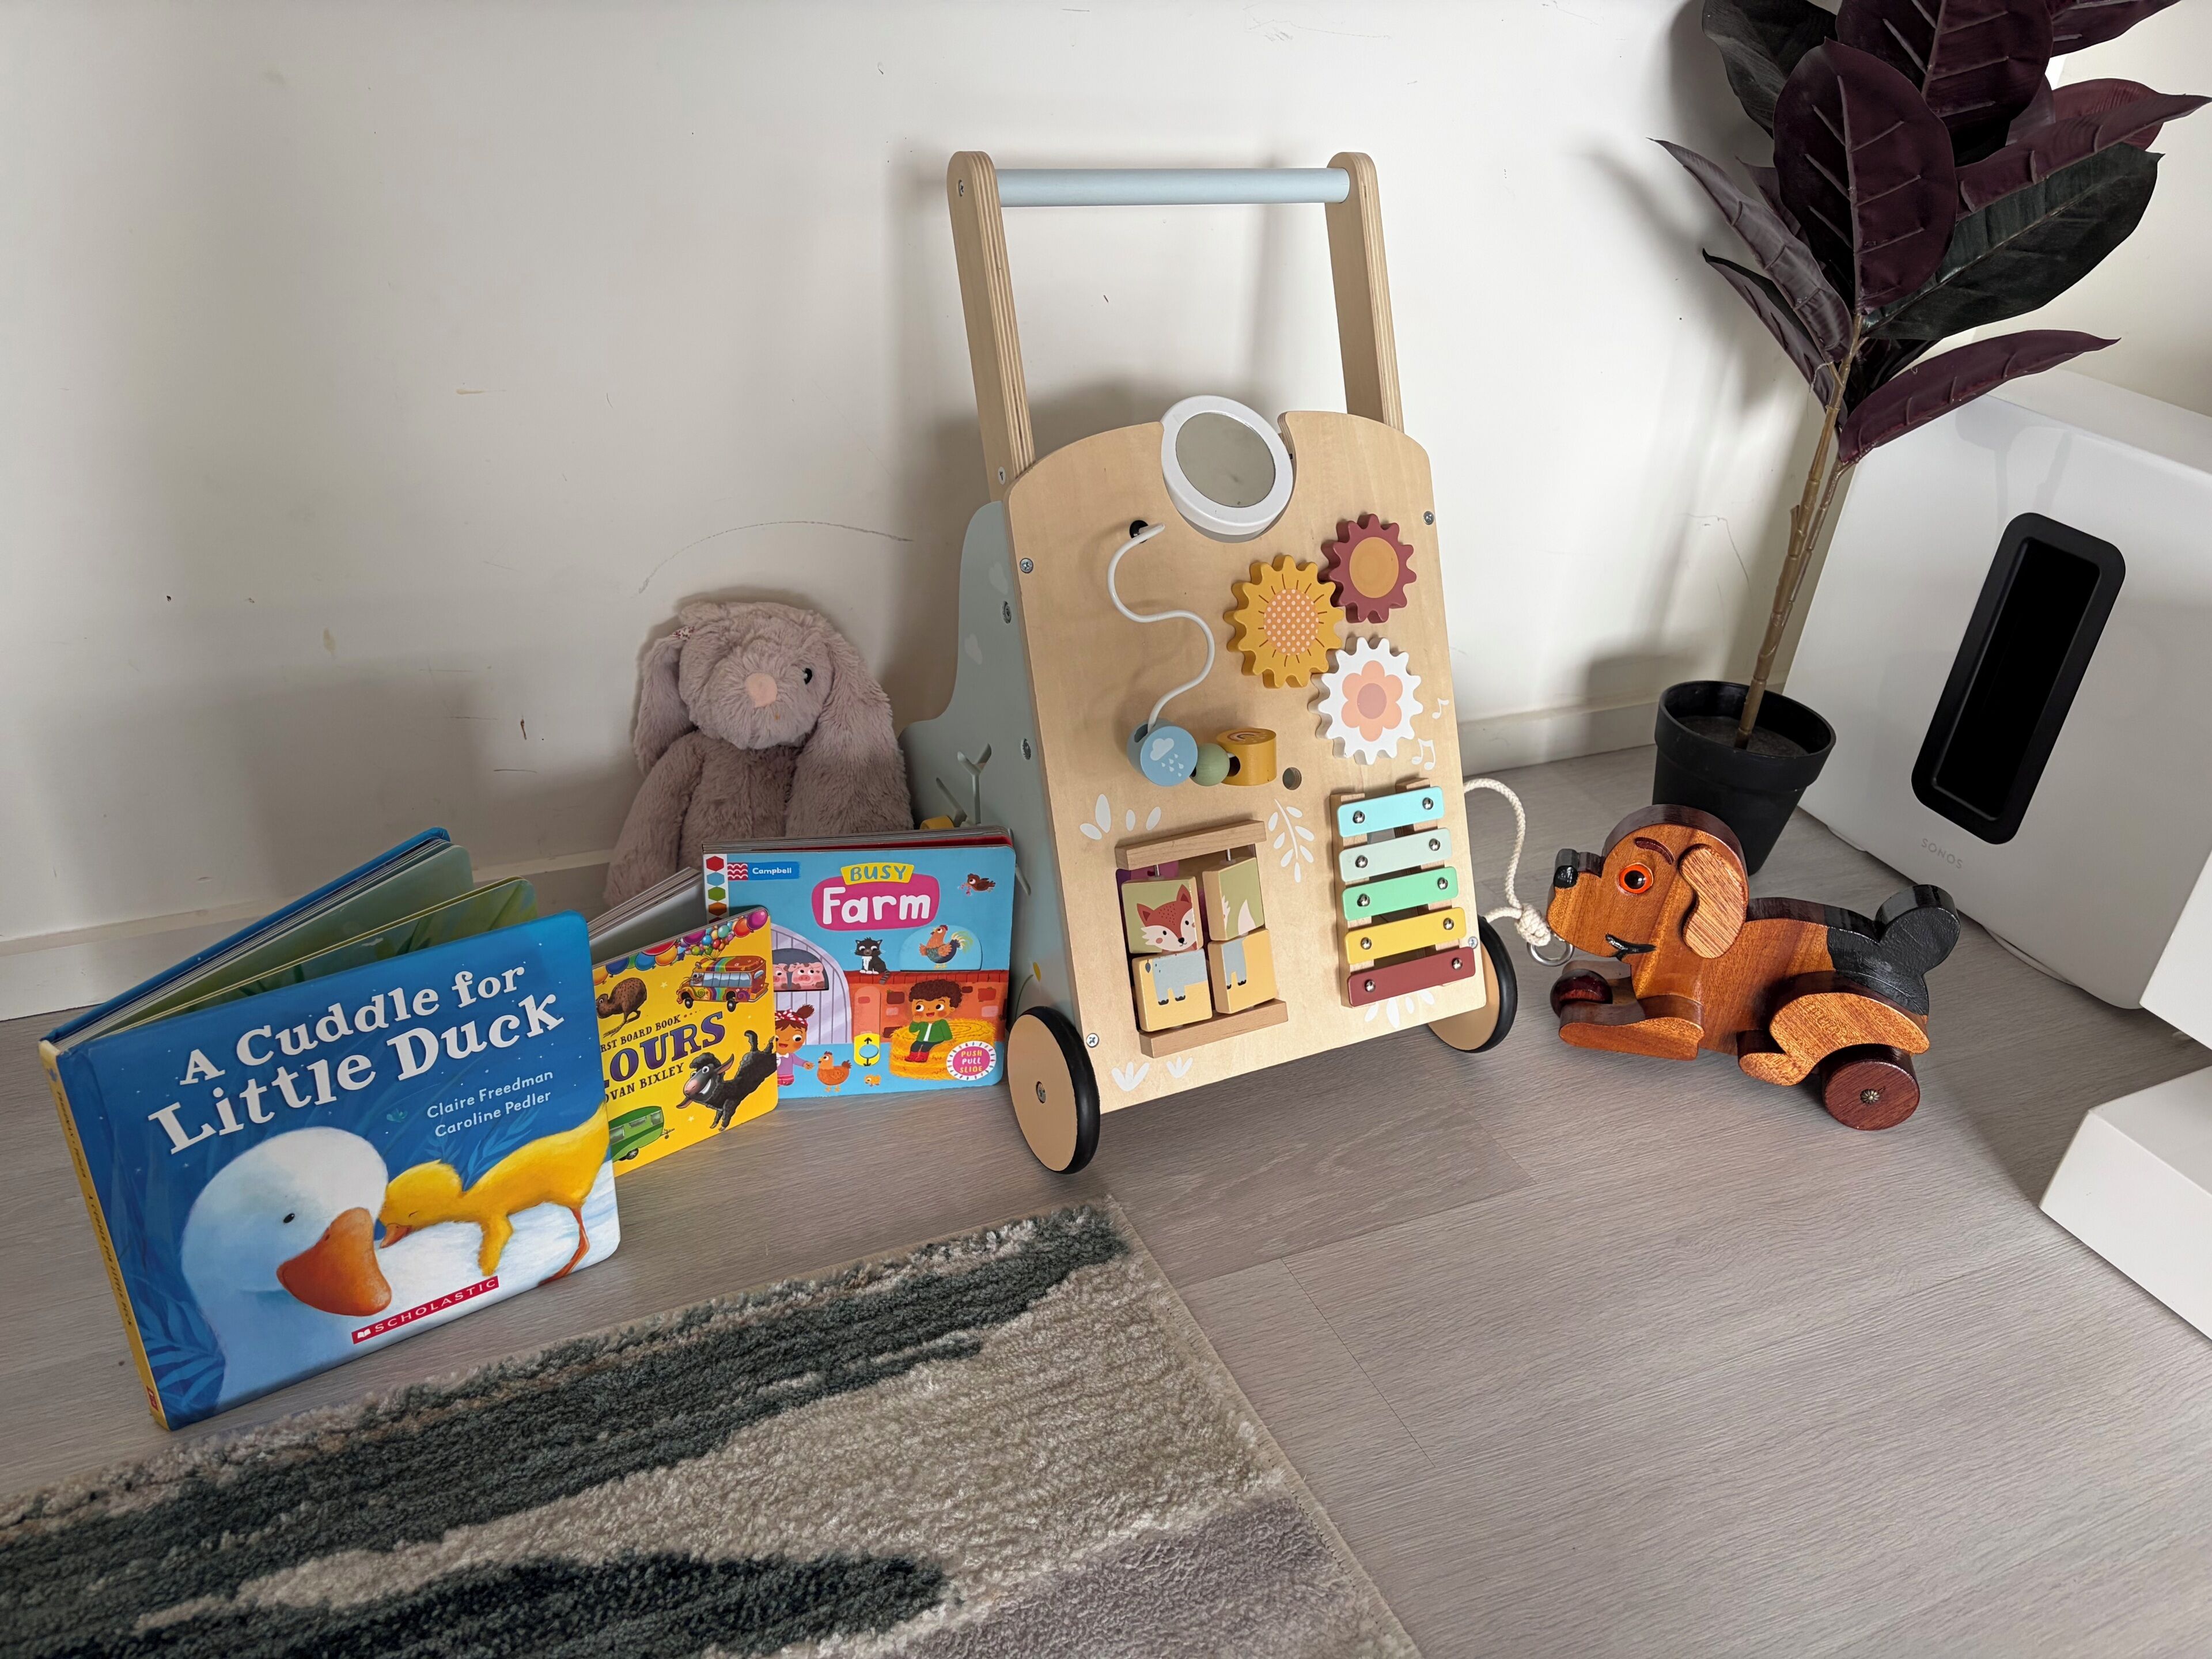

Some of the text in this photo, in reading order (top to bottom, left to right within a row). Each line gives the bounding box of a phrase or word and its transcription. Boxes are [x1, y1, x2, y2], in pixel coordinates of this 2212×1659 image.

[752, 867, 792, 876] Campbell
[1921, 838, 1963, 869] SONOS
[850, 865, 907, 882] BUSY
[823, 887, 931, 925] Farm
[179, 965, 525, 1086] A Cuddle for
[600, 1014, 681, 1053] RST BOARD BOOK
[604, 1011, 725, 1088] OURS
[961, 1050, 983, 1058] PUSH
[961, 1057, 982, 1065] PULL
[147, 994, 565, 1154] Little Duck
[639, 1062, 684, 1089] BIXLEY
[960, 1066, 983, 1074] SLIDE
[427, 1071, 554, 1118] Claire Freedman
[435, 1092, 551, 1137] Caroline Pedler
[374, 1279, 496, 1333] SCHOLASTIC
